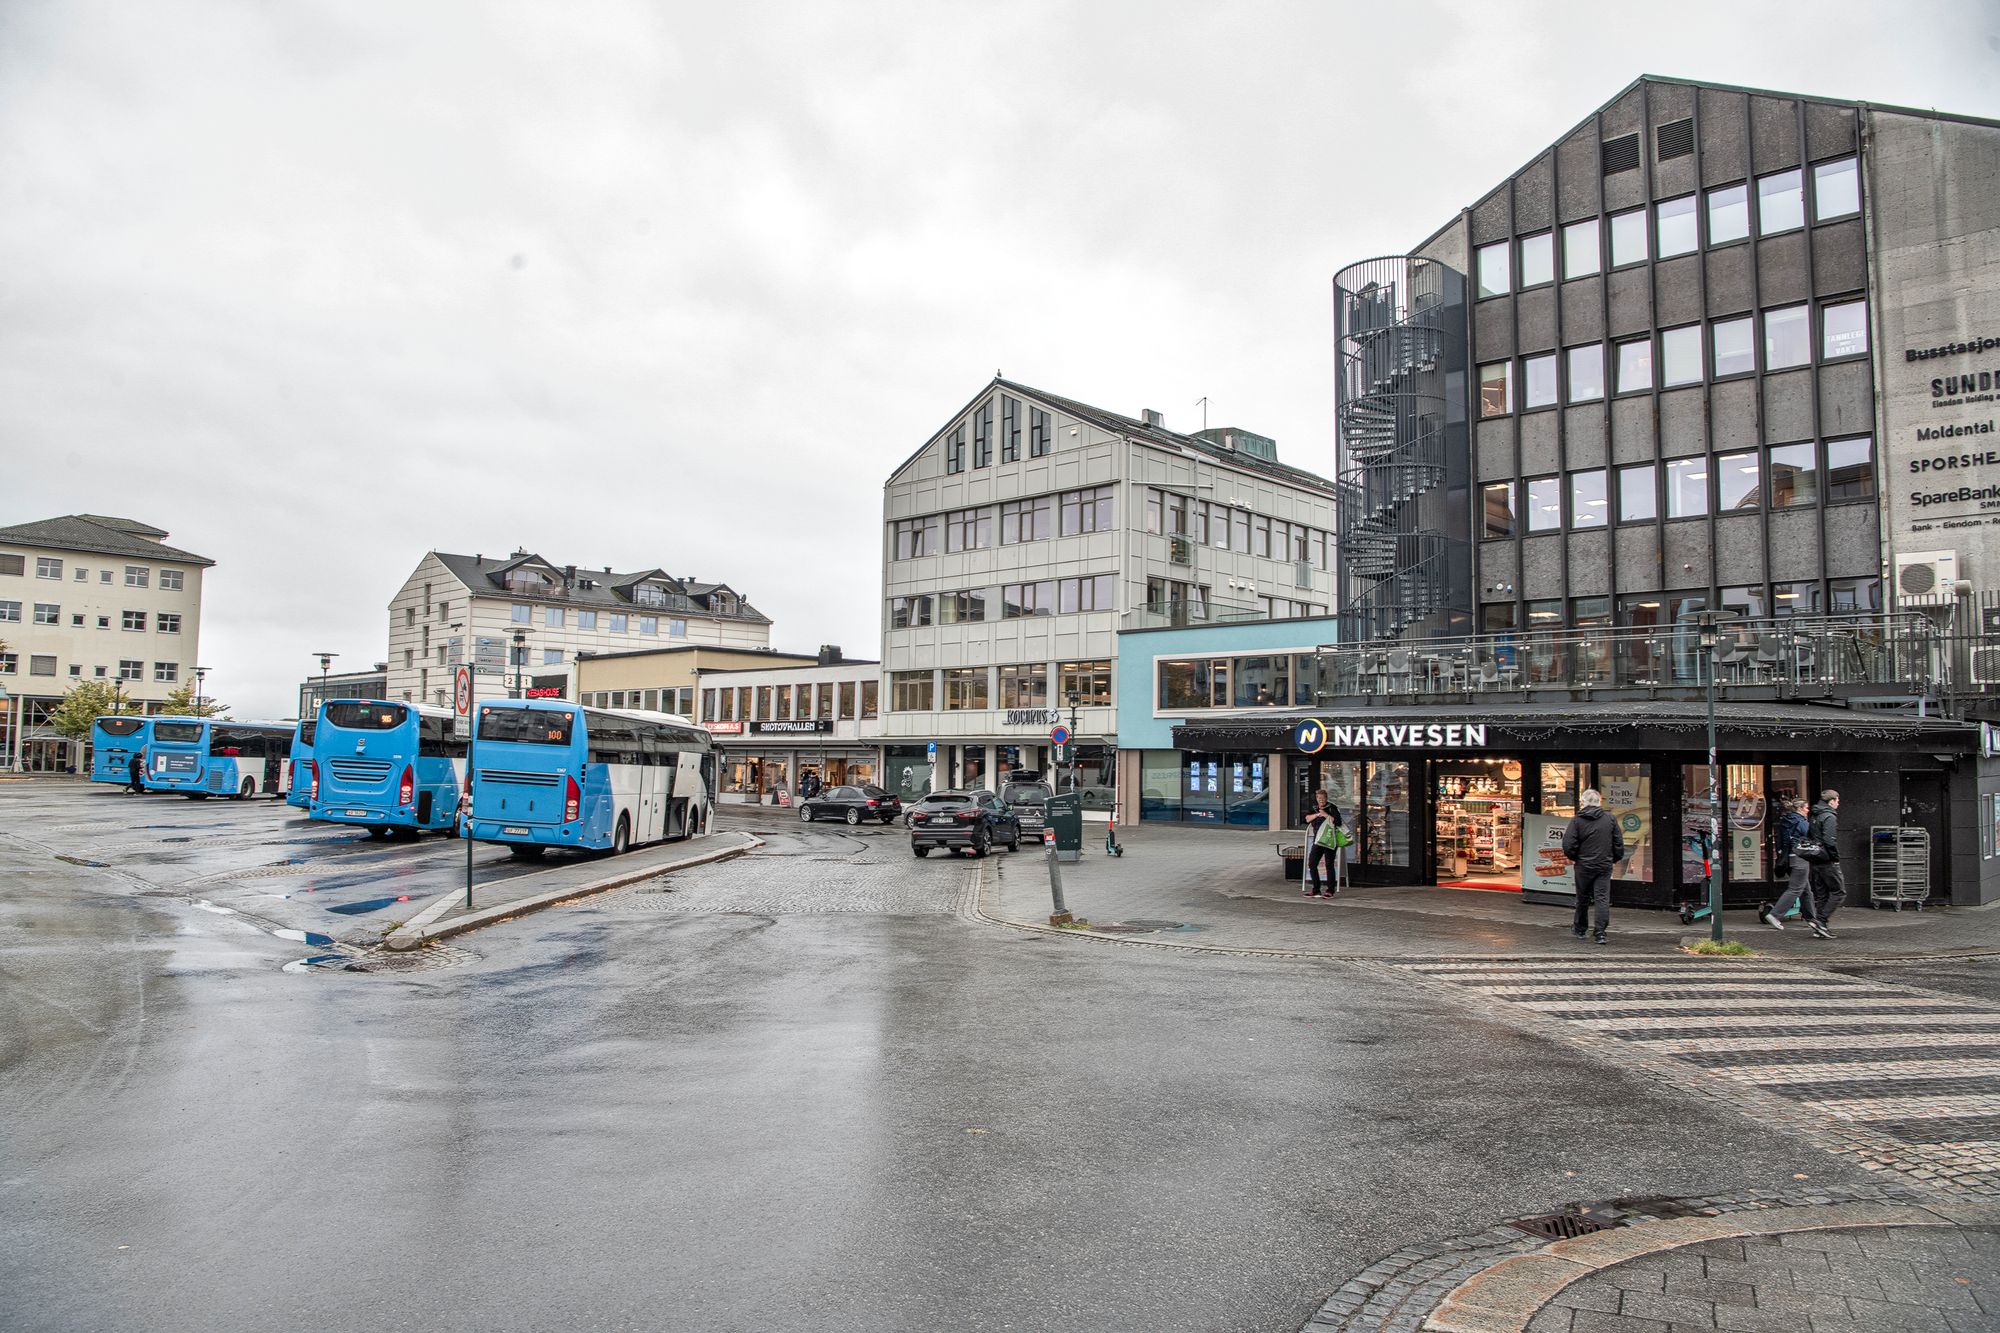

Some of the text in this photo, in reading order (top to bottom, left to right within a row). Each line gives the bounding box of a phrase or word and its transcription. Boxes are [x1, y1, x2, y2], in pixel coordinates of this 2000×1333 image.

[1932, 398, 1963, 408] Eiendom
[1965, 393, 1994, 403] Holding
[1917, 420, 1994, 441] Moldental
[1912, 524, 1932, 532] Bank
[1943, 520, 1982, 528] Eiendom
[548, 730, 562, 740] 100
[1334, 724, 1487, 747] NARVESEN
[1548, 830, 1564, 840] 29
